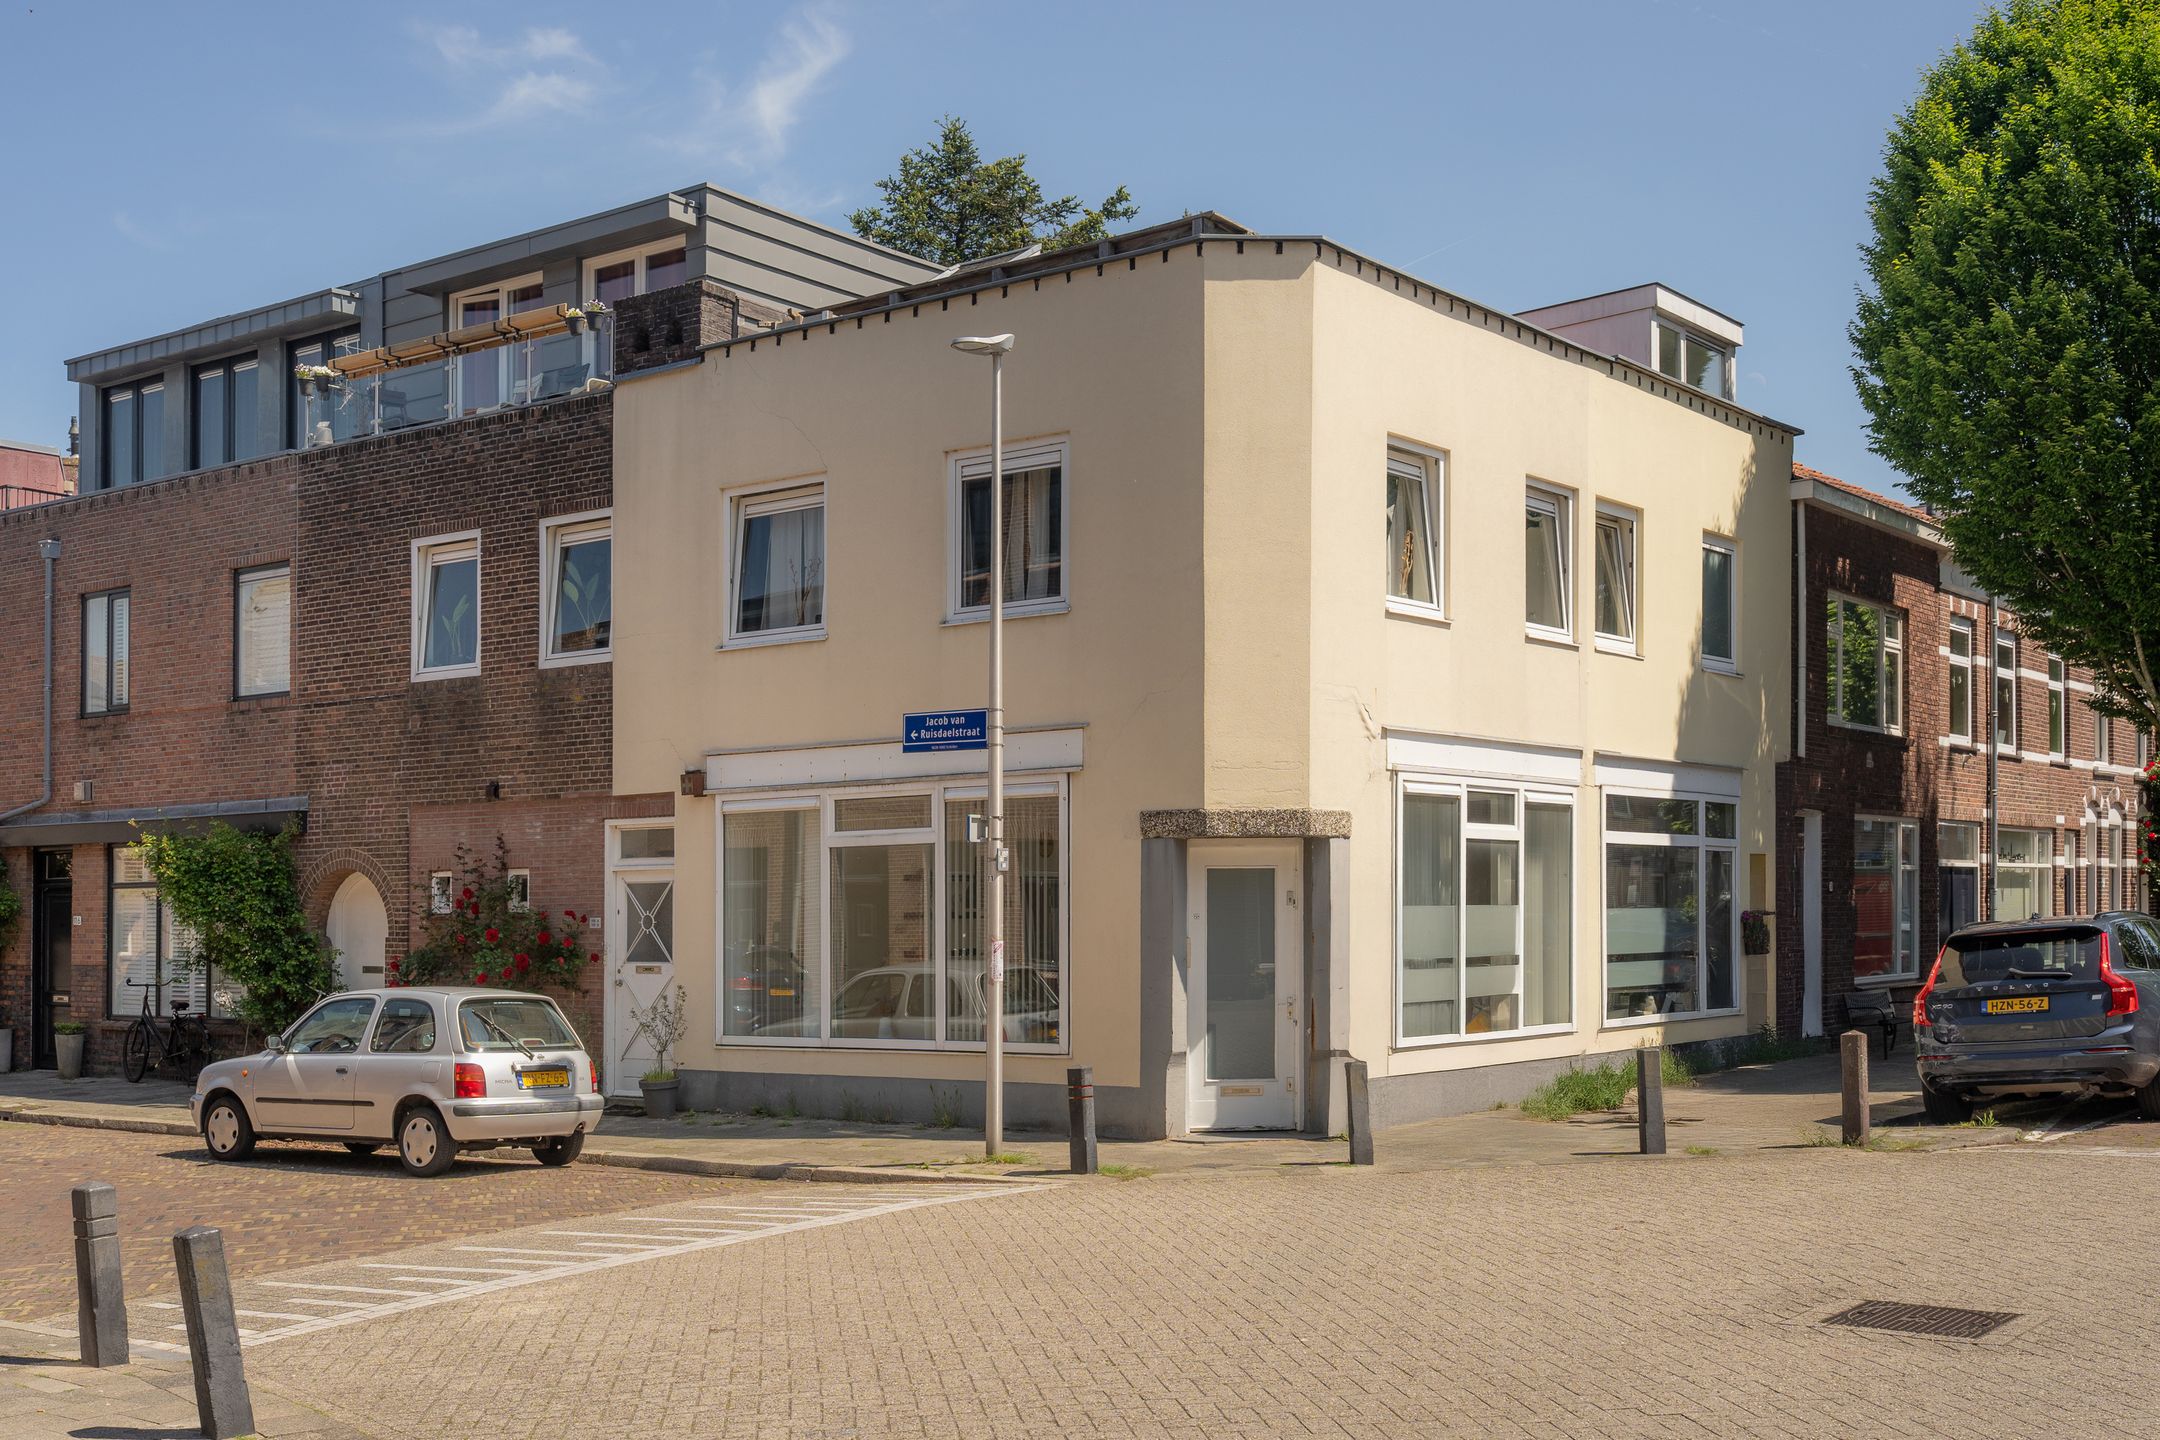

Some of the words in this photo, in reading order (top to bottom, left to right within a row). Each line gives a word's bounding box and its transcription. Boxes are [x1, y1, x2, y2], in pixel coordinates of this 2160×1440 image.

[926, 716, 948, 726] Jacob
[950, 716, 965, 725] van
[920, 727, 980, 739] Ruisdaelstraat
[1976, 982, 2049, 992] VOLVO
[1991, 999, 2044, 1011] HZN-56-Z
